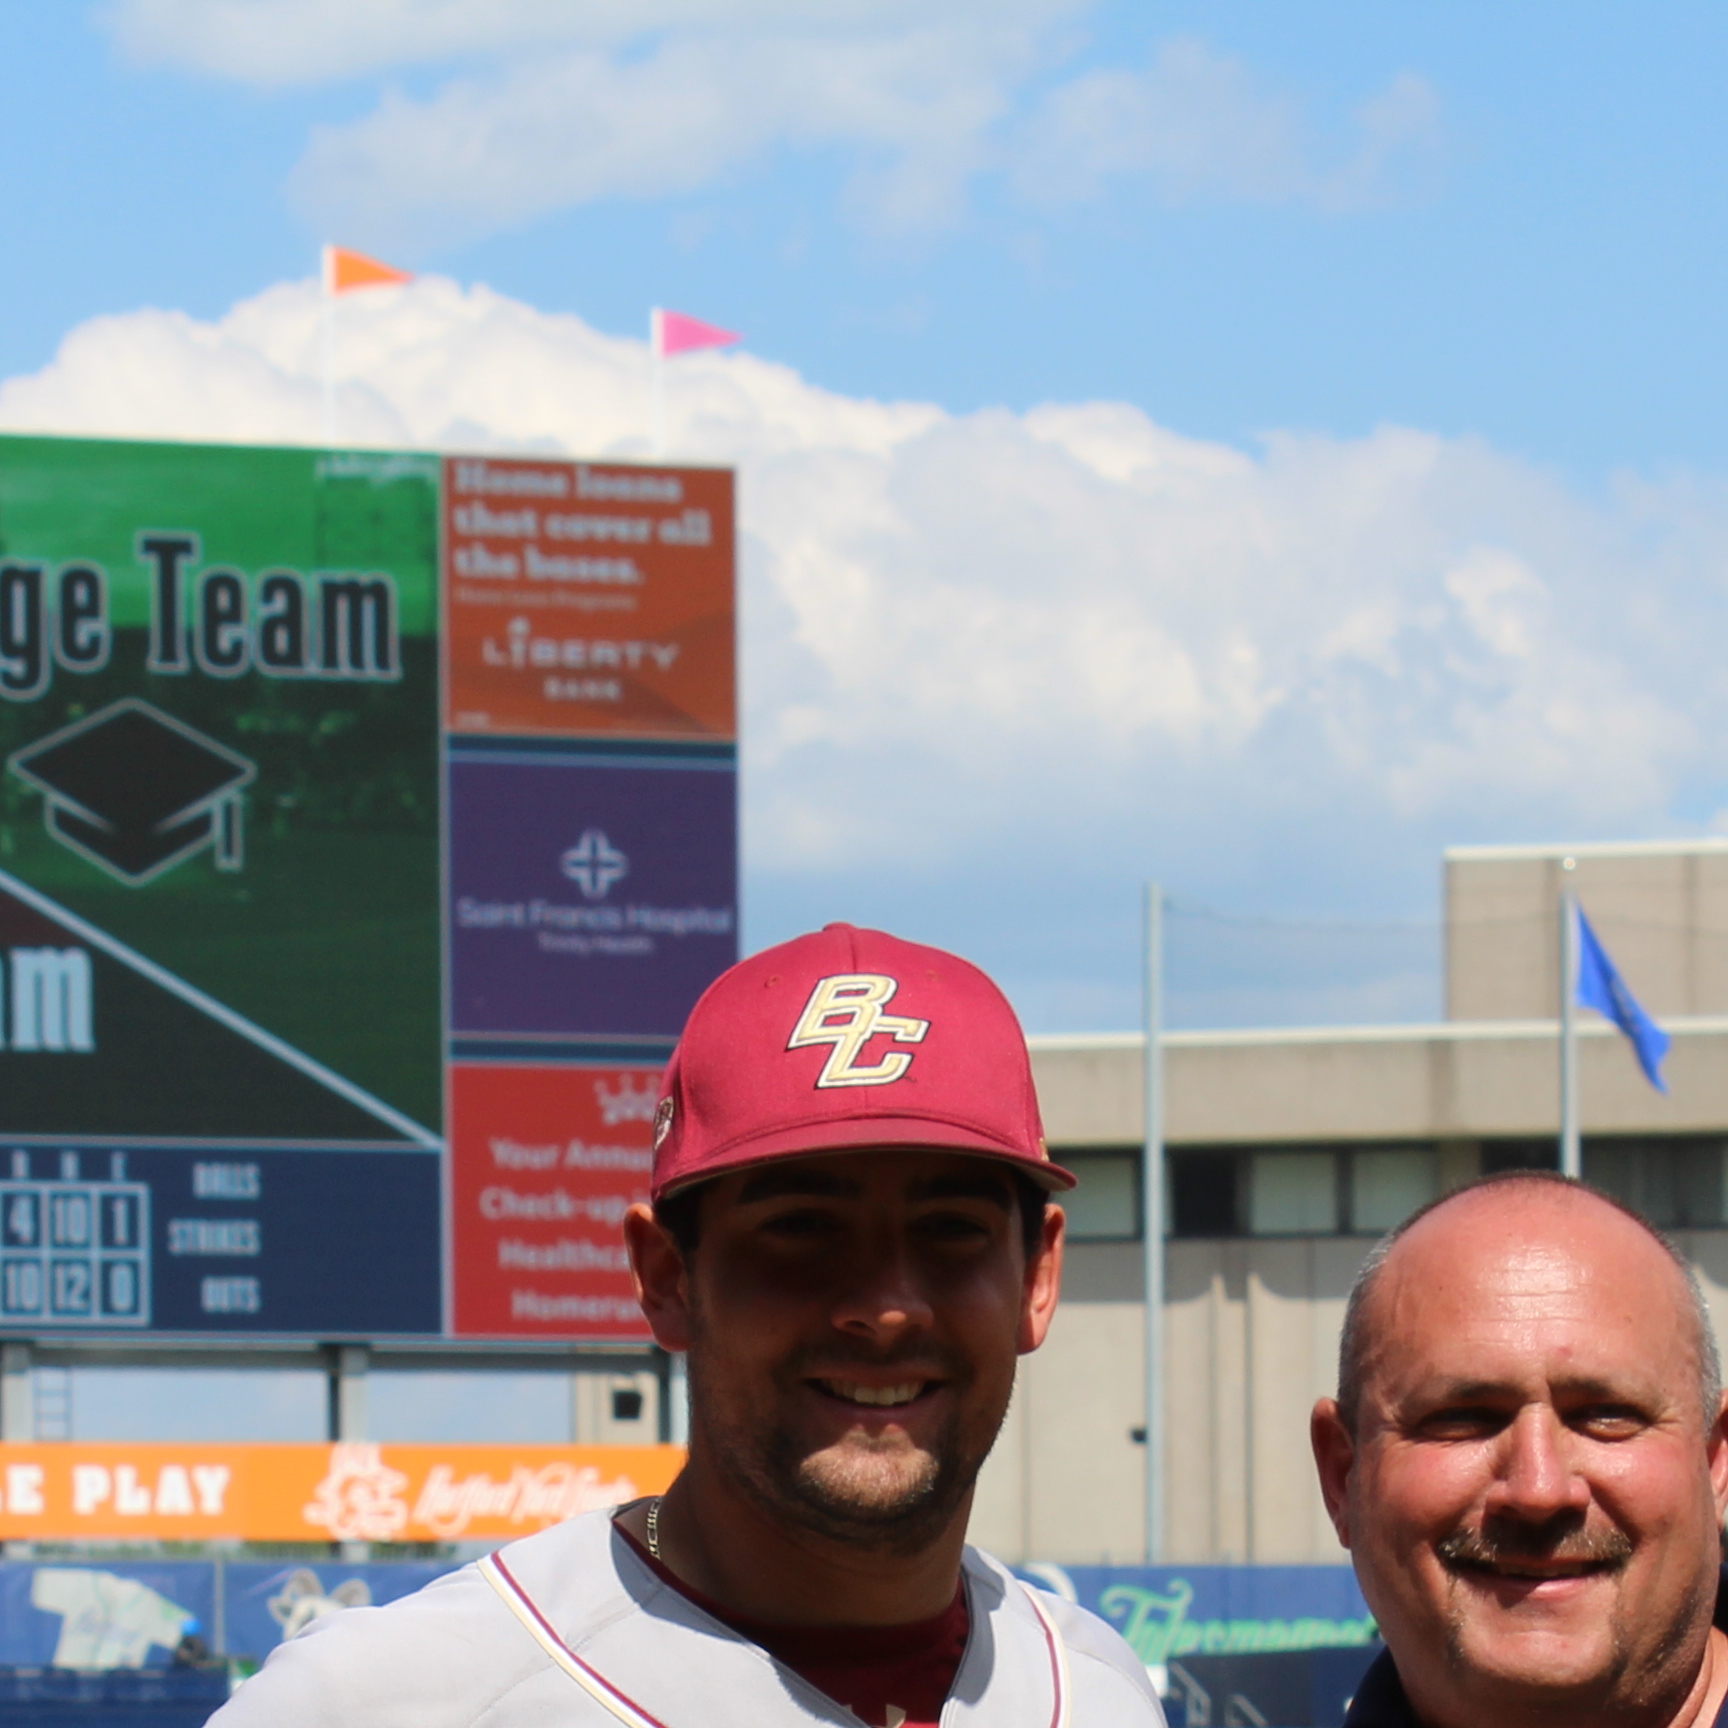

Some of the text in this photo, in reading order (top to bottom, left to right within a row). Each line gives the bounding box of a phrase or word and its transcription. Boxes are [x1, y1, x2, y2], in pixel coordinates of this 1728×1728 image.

[454, 500, 711, 546] that cover all
[453, 541, 518, 580] the
[135, 529, 402, 684] Team
[786, 973, 932, 1090] BC
[9, 1195, 33, 1244] 4
[54, 1196, 89, 1245] 10
[111, 1198, 128, 1245] 1
[6, 1263, 39, 1311] 10
[56, 1264, 90, 1311] 12
[110, 1264, 135, 1313] 0
[73, 1463, 230, 1517] PLAY
